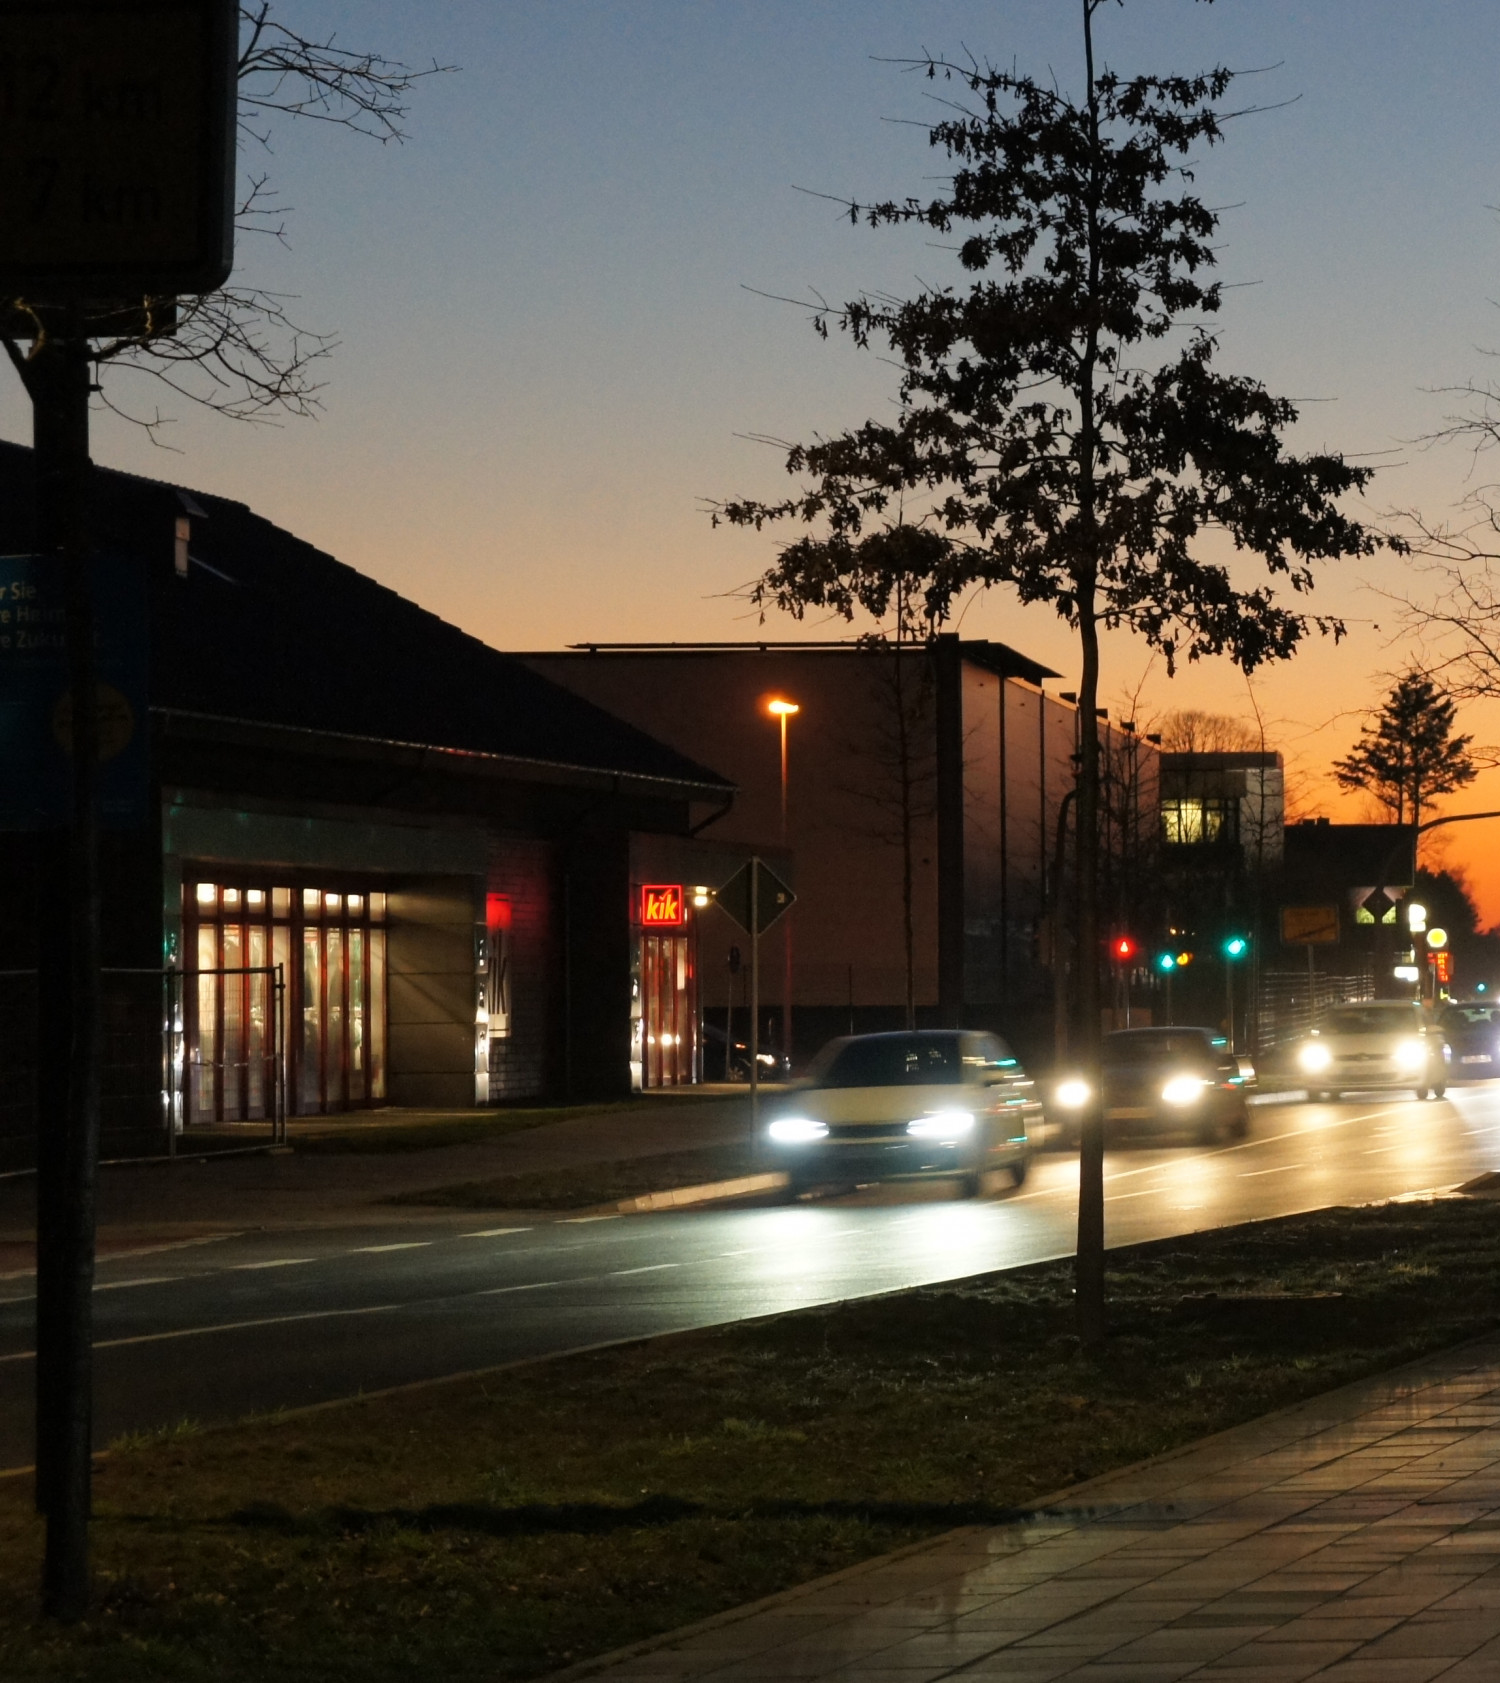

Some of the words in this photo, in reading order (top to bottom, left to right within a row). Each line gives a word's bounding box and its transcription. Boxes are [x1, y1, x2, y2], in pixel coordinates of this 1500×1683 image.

[84, 68, 161, 120] km
[26, 155, 61, 223] 7
[82, 174, 161, 223] km
[11, 581, 37, 600] Sie
